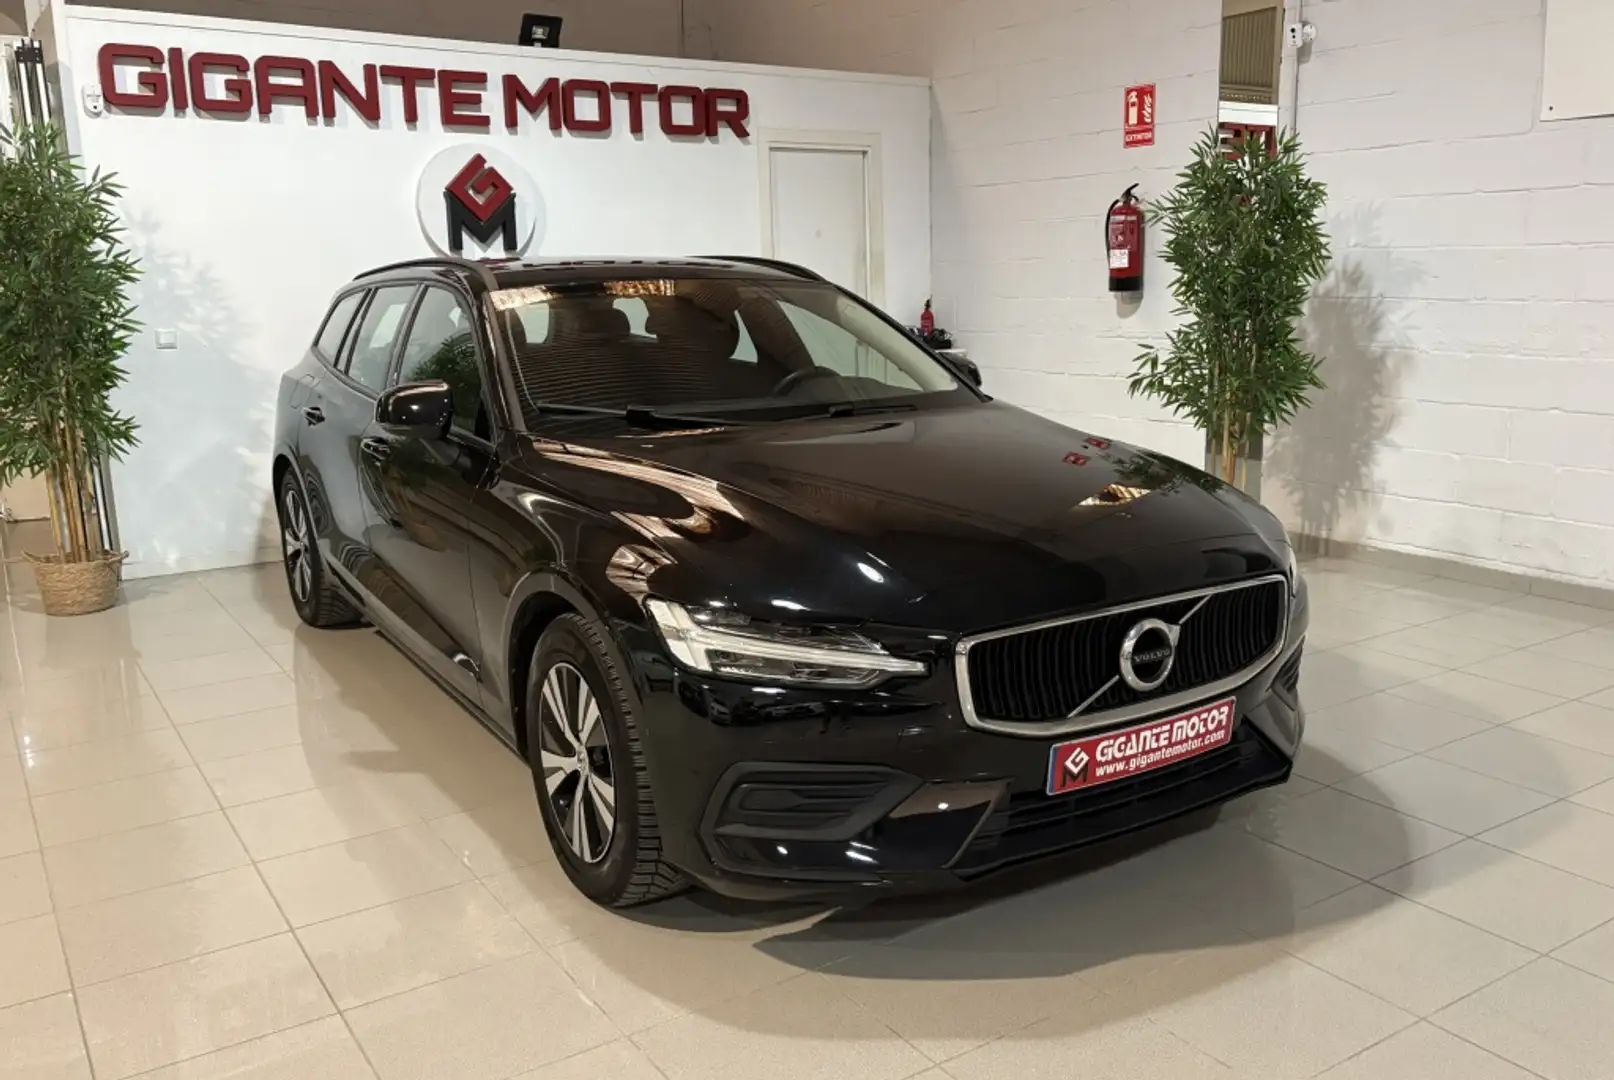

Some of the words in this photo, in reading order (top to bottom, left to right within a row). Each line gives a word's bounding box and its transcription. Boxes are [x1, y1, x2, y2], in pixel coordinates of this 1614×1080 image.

[98, 42, 490, 127] GIGANTE
[502, 74, 750, 138] MOTOR
[1134, 650, 1170, 662] VOLVO
[1095, 724, 1170, 762] GIGANTE
[1172, 706, 1229, 742] MOTOR
[1096, 730, 1225, 777] www.gigantemotor.com
